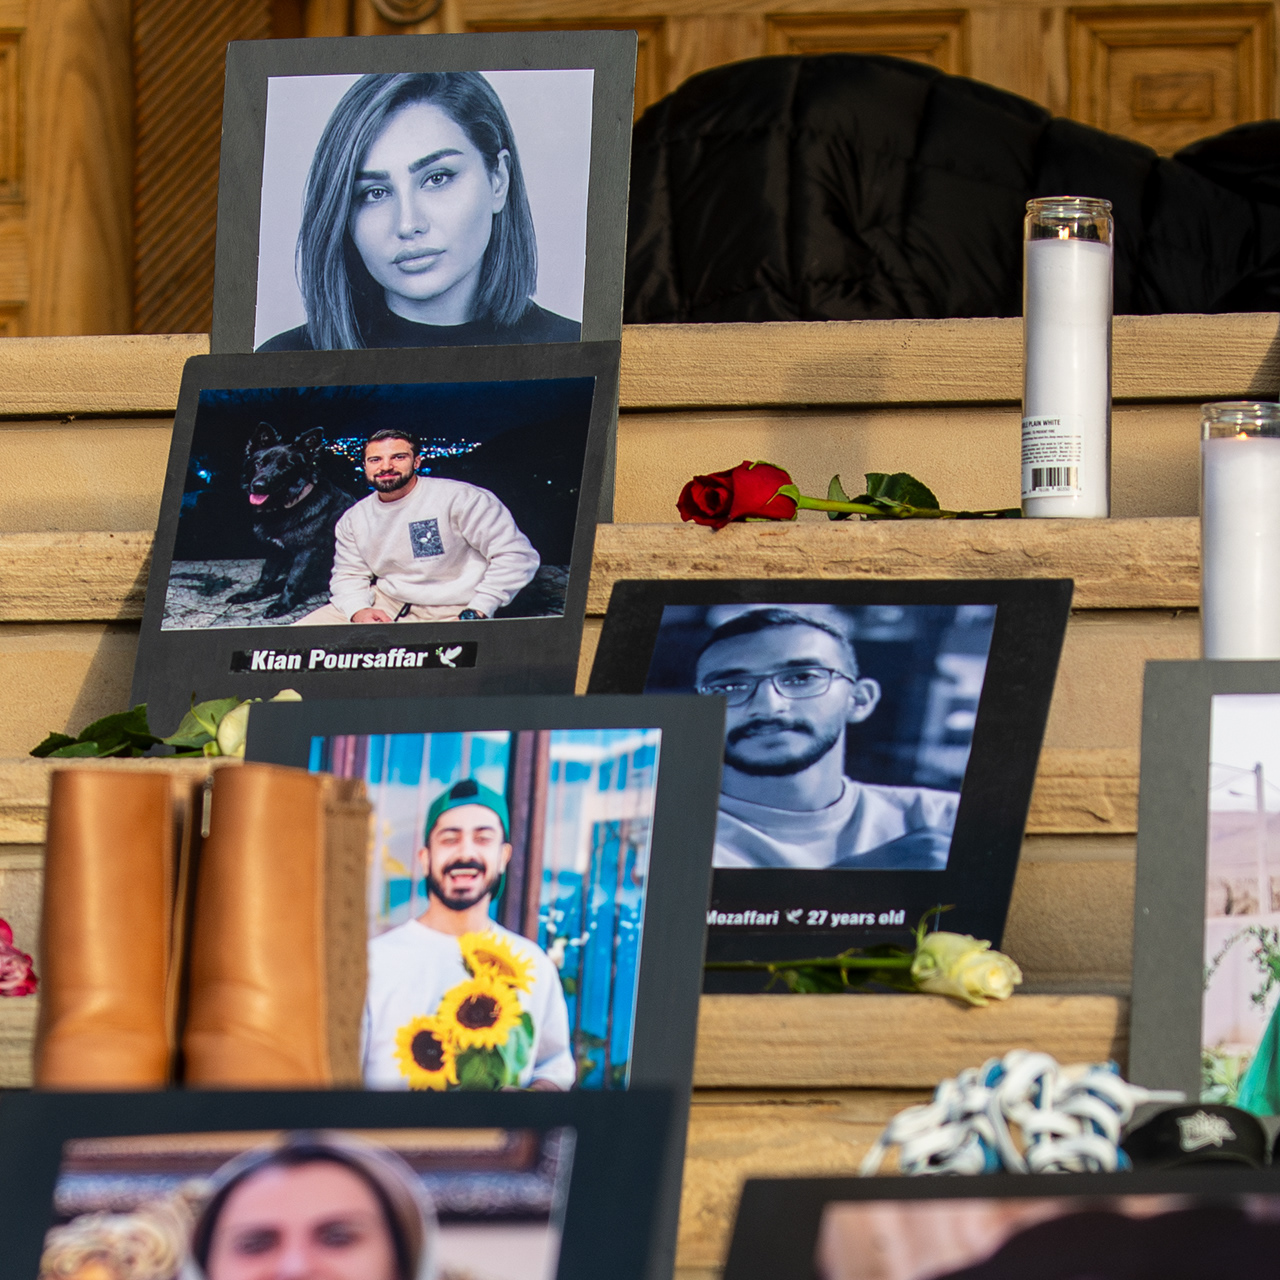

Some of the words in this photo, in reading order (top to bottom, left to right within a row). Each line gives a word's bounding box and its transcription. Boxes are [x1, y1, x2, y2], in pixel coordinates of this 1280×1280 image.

[251, 650, 302, 670] Kian
[308, 648, 429, 669] Poursaffar
[807, 909, 828, 926] 27
[831, 912, 875, 928] years
[878, 909, 905, 926] old
